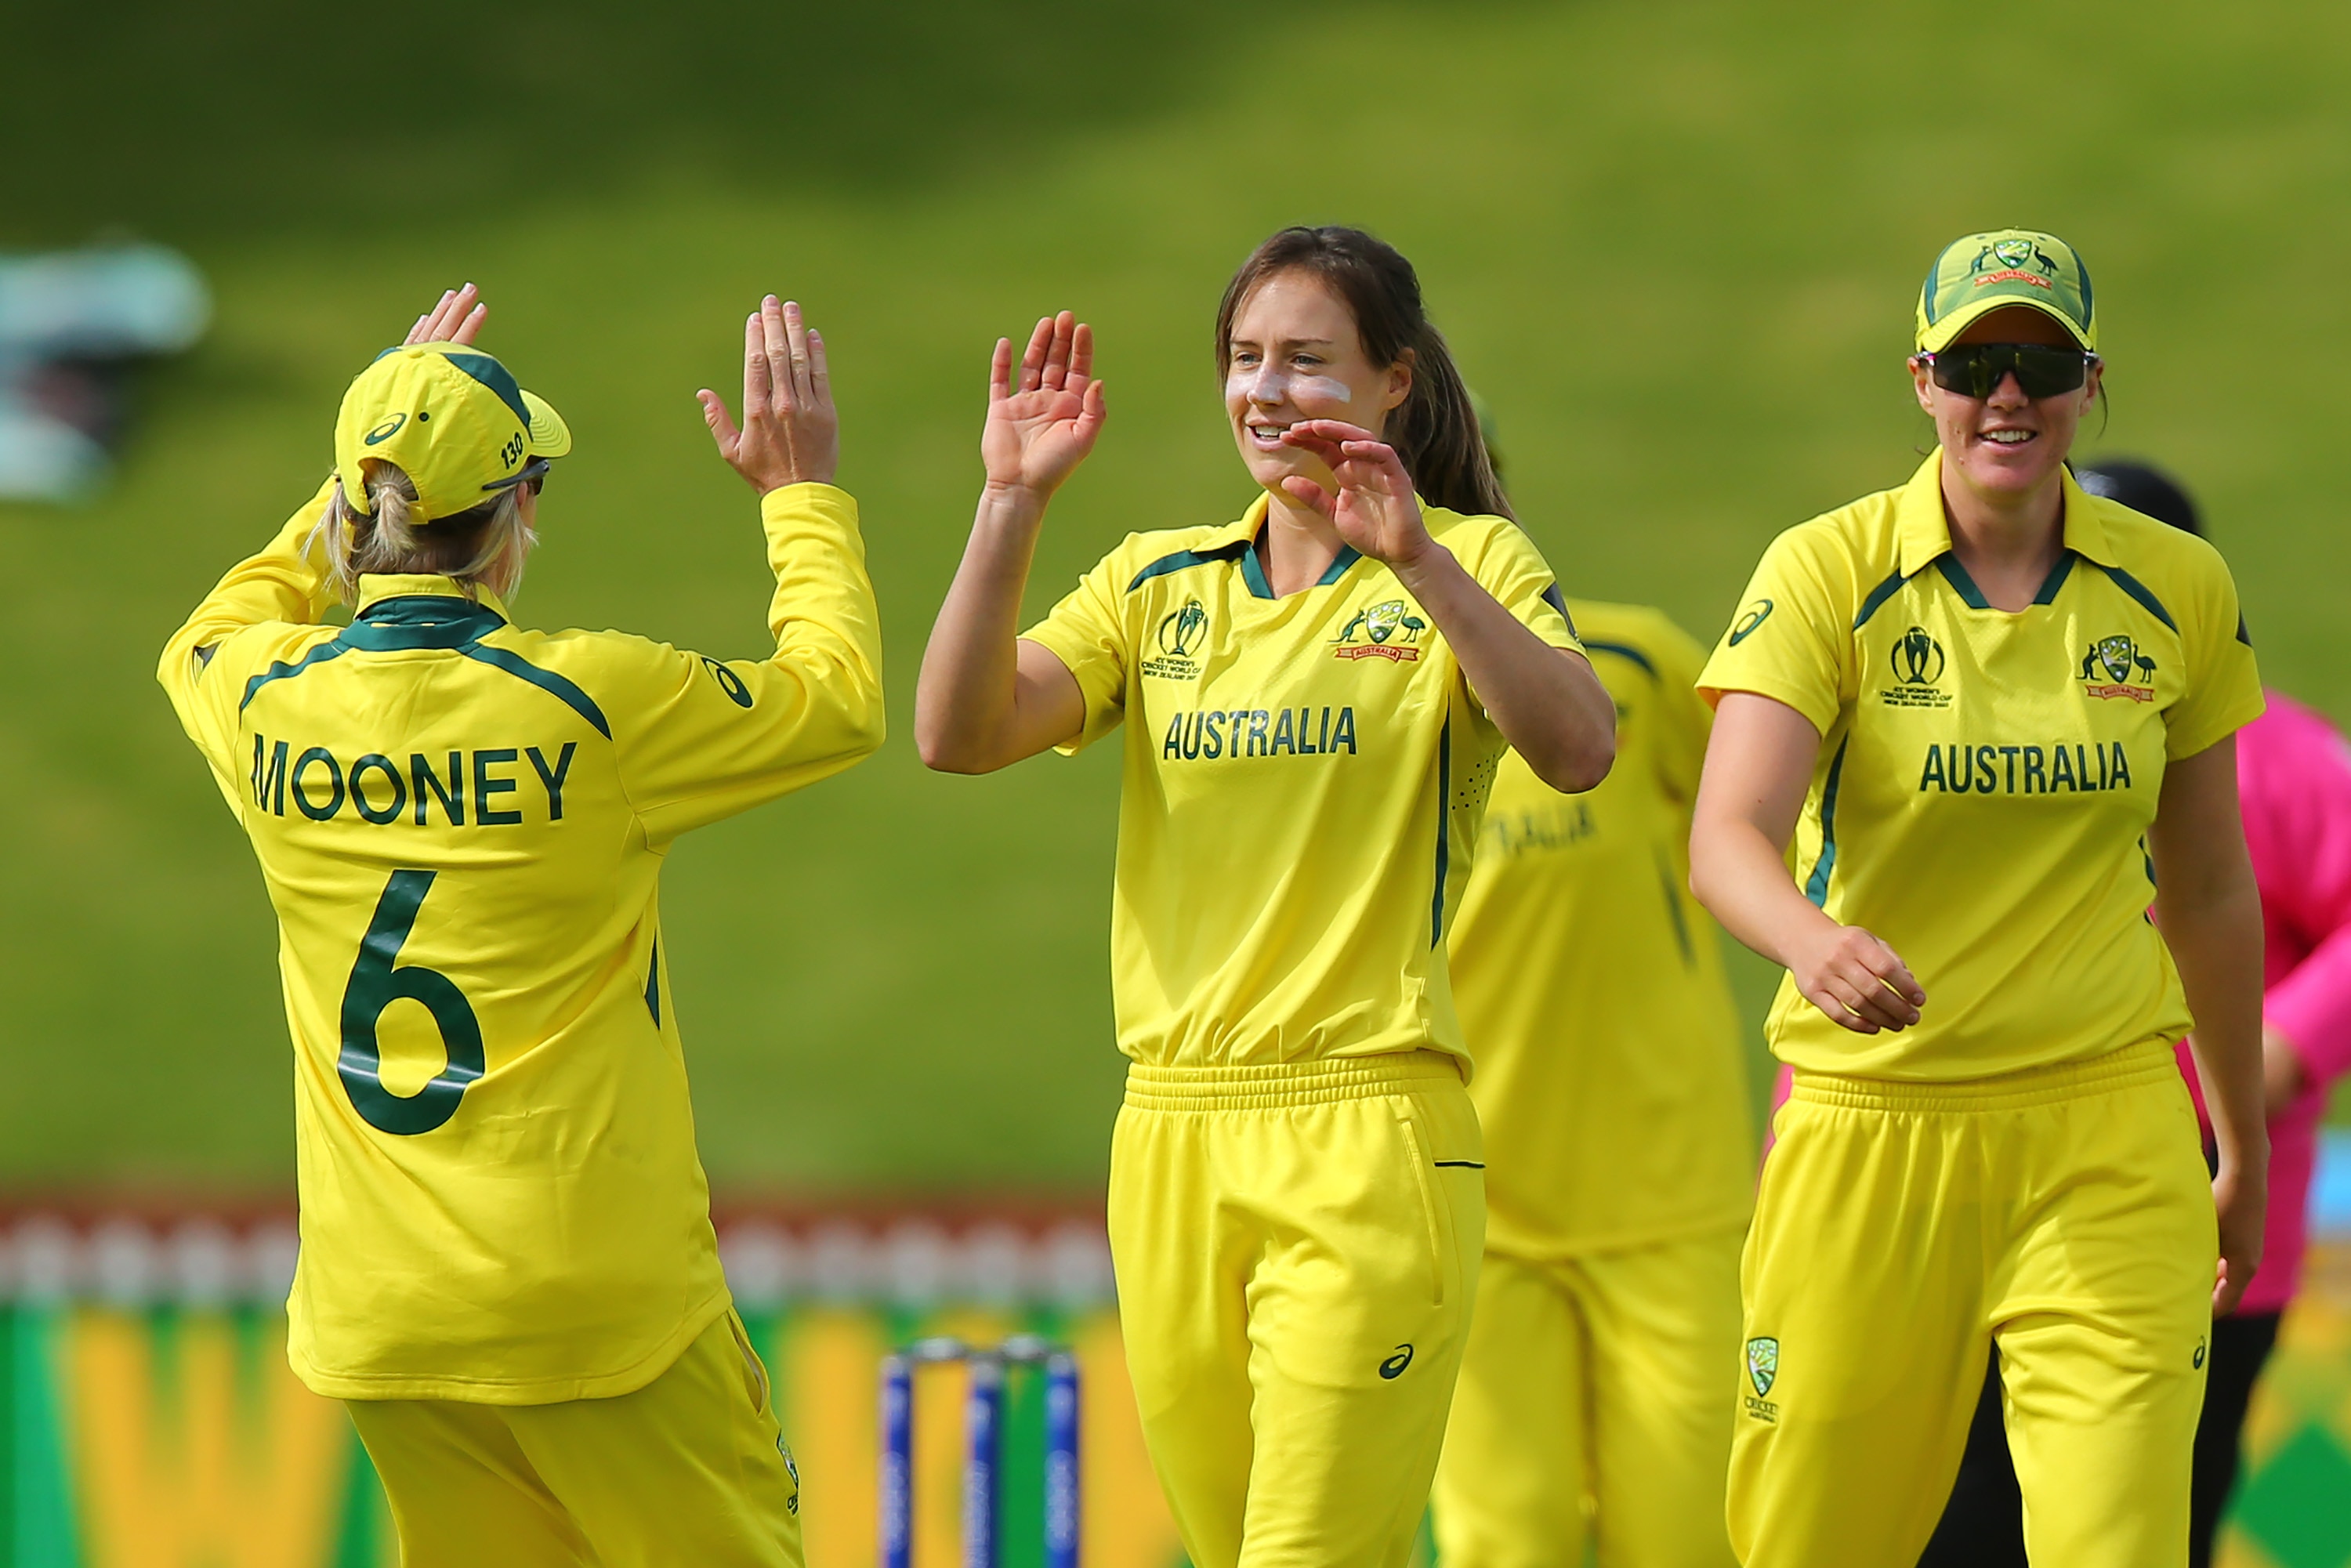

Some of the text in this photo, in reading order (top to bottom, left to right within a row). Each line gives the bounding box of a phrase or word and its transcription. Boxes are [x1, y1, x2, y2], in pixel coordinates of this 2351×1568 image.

[501, 432, 523, 469] 130
[1356, 646, 1397, 657] AUSTRALIA
[1164, 707, 1357, 760] AUSTRALIA
[251, 733, 578, 826] MOONEY
[1919, 741, 2131, 794] AUSTRALIA
[337, 870, 485, 1135] 6
